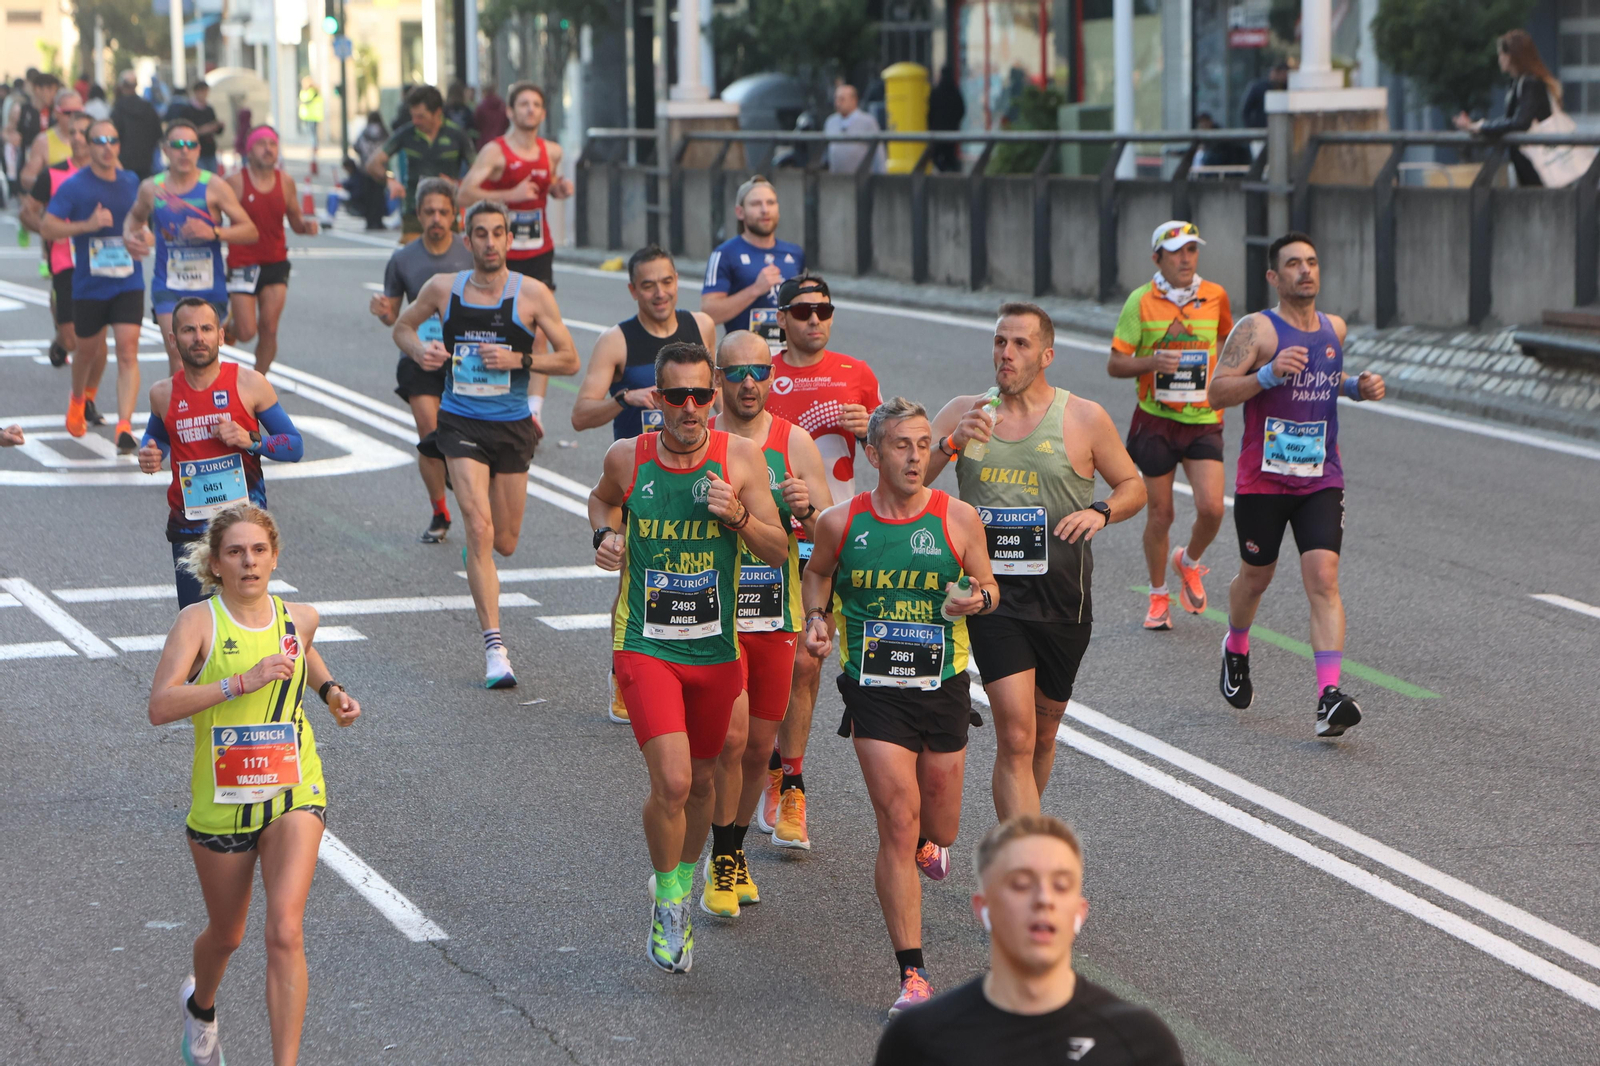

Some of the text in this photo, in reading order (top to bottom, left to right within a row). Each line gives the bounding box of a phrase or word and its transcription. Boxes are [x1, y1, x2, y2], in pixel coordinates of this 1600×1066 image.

[176, 418, 193, 430] CLUB
[1286, 443, 1306, 452] 4667
[200, 459, 234, 473] ZURICH
[979, 467, 1039, 486] BIKILA
[203, 482, 223, 492] 6451
[204, 494, 228, 505] JORGE
[996, 513, 1036, 522] ZURICH
[638, 518, 722, 540] BIKILA
[996, 535, 1020, 546] 2849
[680, 551, 714, 565] RUN
[994, 550, 1025, 559] ALVARO
[740, 571, 776, 581] ZURICH
[851, 570, 939, 590] BIKILA
[673, 577, 709, 588] ZURICH
[738, 593, 761, 604] 2722
[672, 600, 696, 611] 2493
[896, 600, 933, 614] RUN
[738, 608, 760, 617] CHULI
[670, 616, 698, 624] ANGEL
[892, 628, 934, 640] ZURICH
[890, 650, 914, 662] 2661
[888, 666, 916, 676] JESUS
[242, 729, 286, 742] ZURICH
[242, 756, 269, 769] 1171
[236, 773, 279, 786] VAZQUEZ
